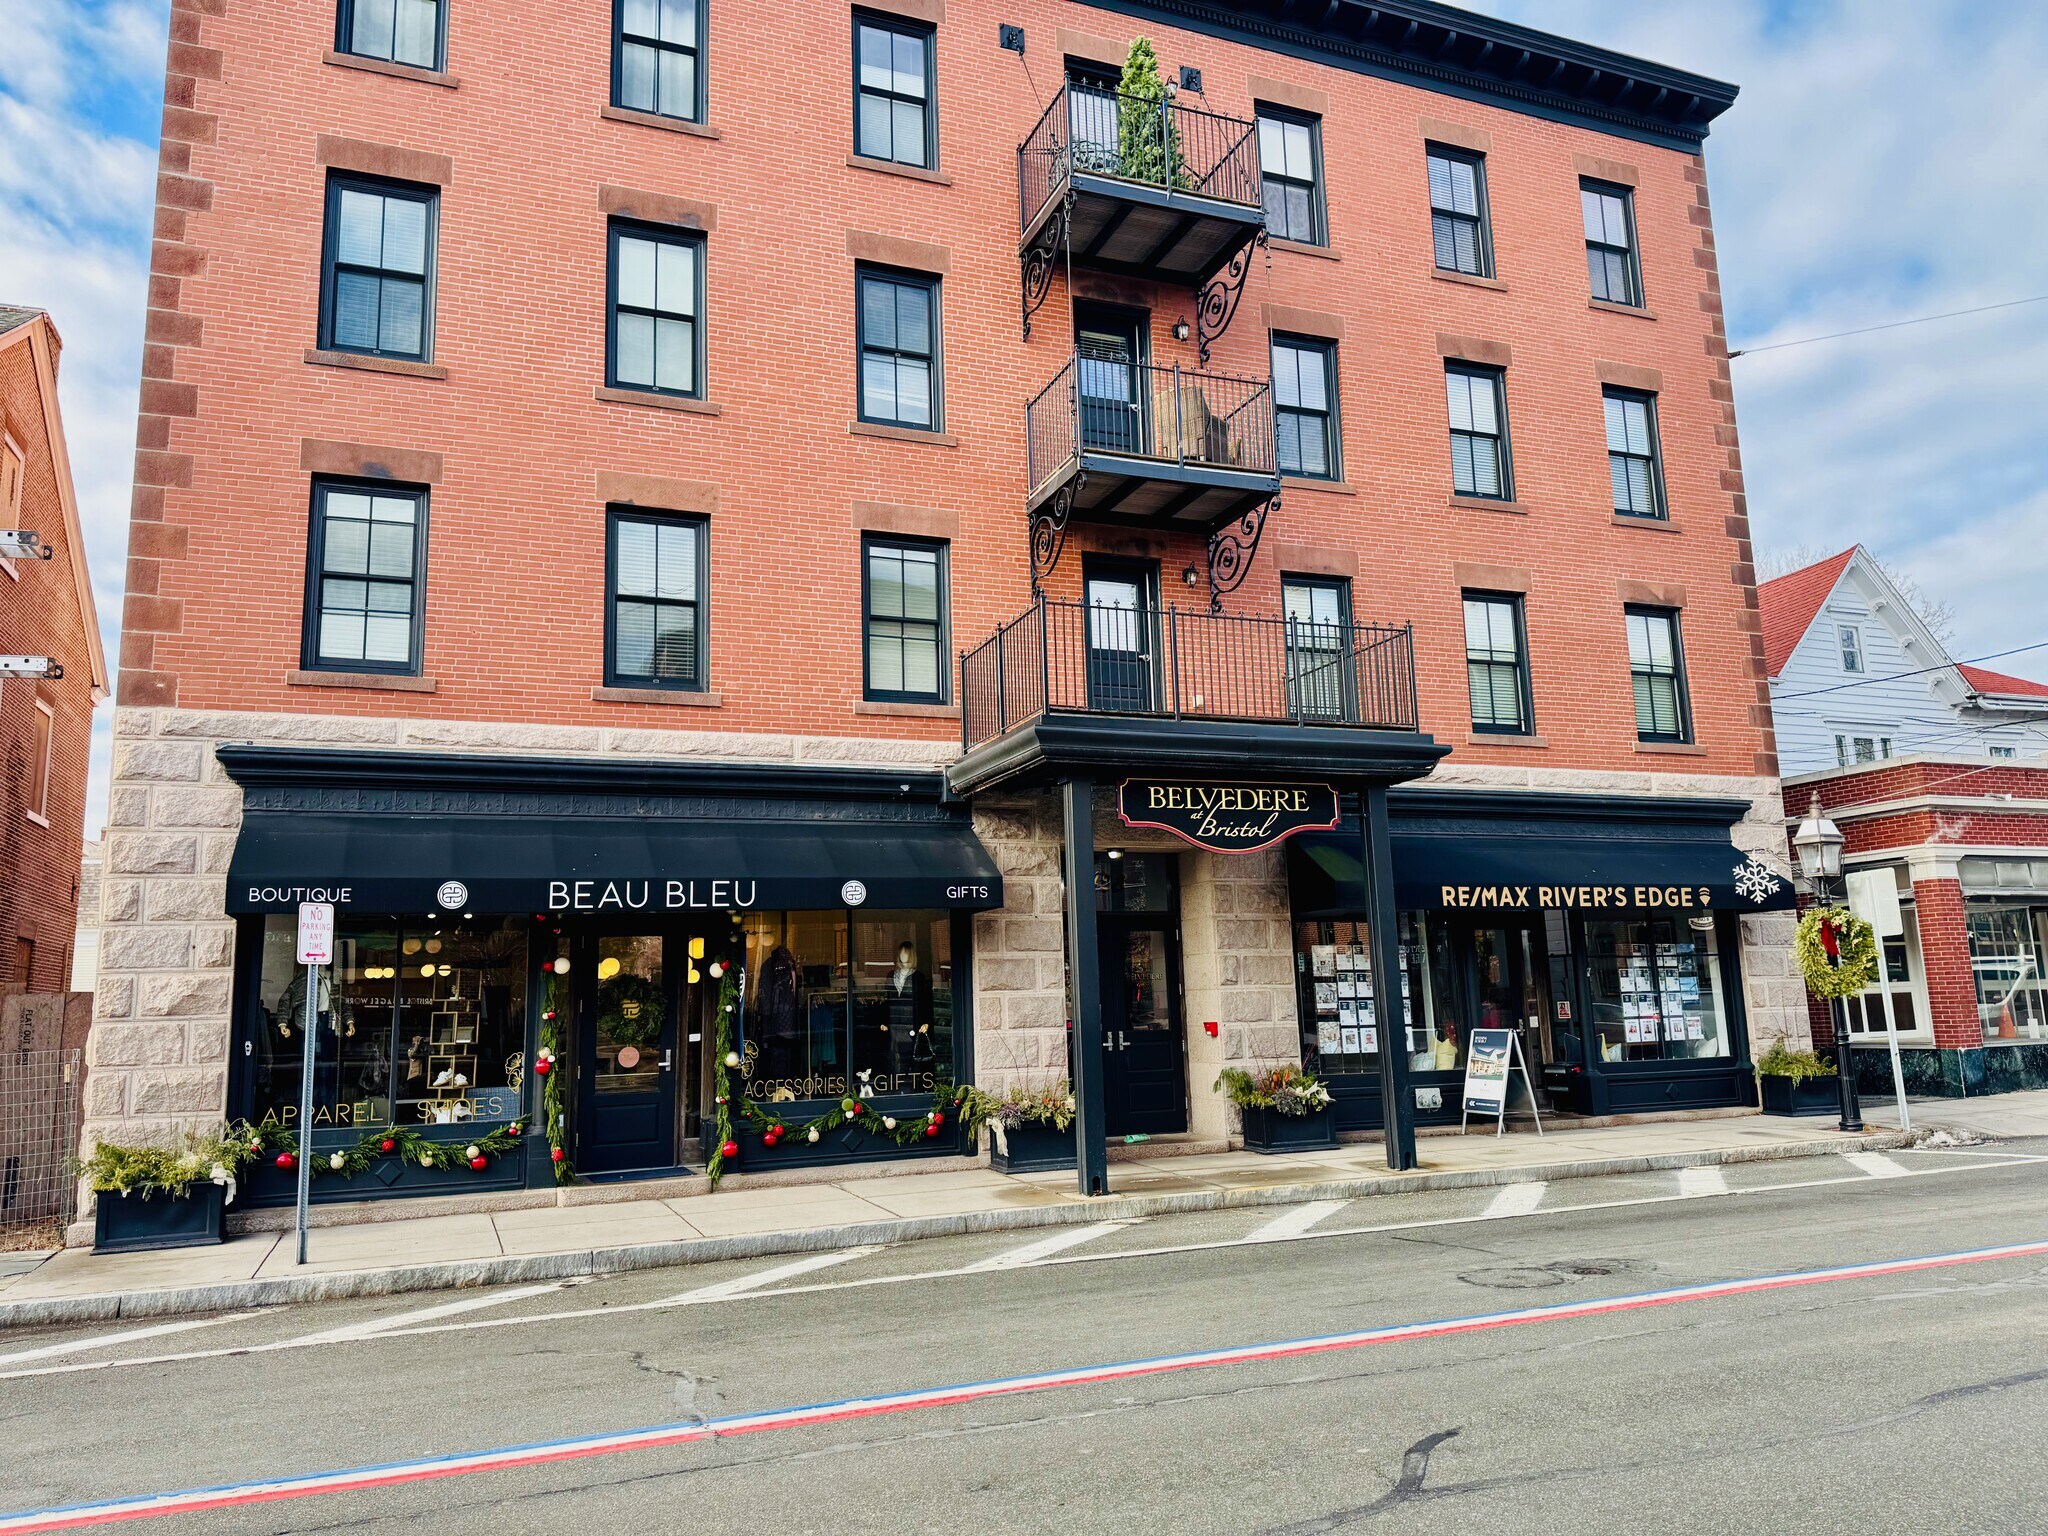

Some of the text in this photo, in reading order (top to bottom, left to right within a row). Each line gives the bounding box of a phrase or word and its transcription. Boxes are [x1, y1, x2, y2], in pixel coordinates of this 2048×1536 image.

[1148, 786, 1309, 811] BELVEDERE
[1190, 810, 1203, 820] at
[1196, 798, 1279, 837] Bristol
[249, 887, 351, 902] BOUTIQUE
[549, 880, 756, 909] BEAU BLEU
[946, 885, 988, 900] GIFTS
[1441, 885, 1694, 907] RE/MAX RIVER'S EDGE
[310, 909, 323, 921] NO
[302, 922, 331, 931] PARKING
[309, 932, 323, 941] ANY
[309, 942, 323, 951] TIME
[21, 1009, 33, 1066] FLAT OUT BEST
[744, 1076, 846, 1098] ACCESSORIES
[873, 1072, 934, 1092] GIFTS
[416, 1096, 503, 1119] SHOES
